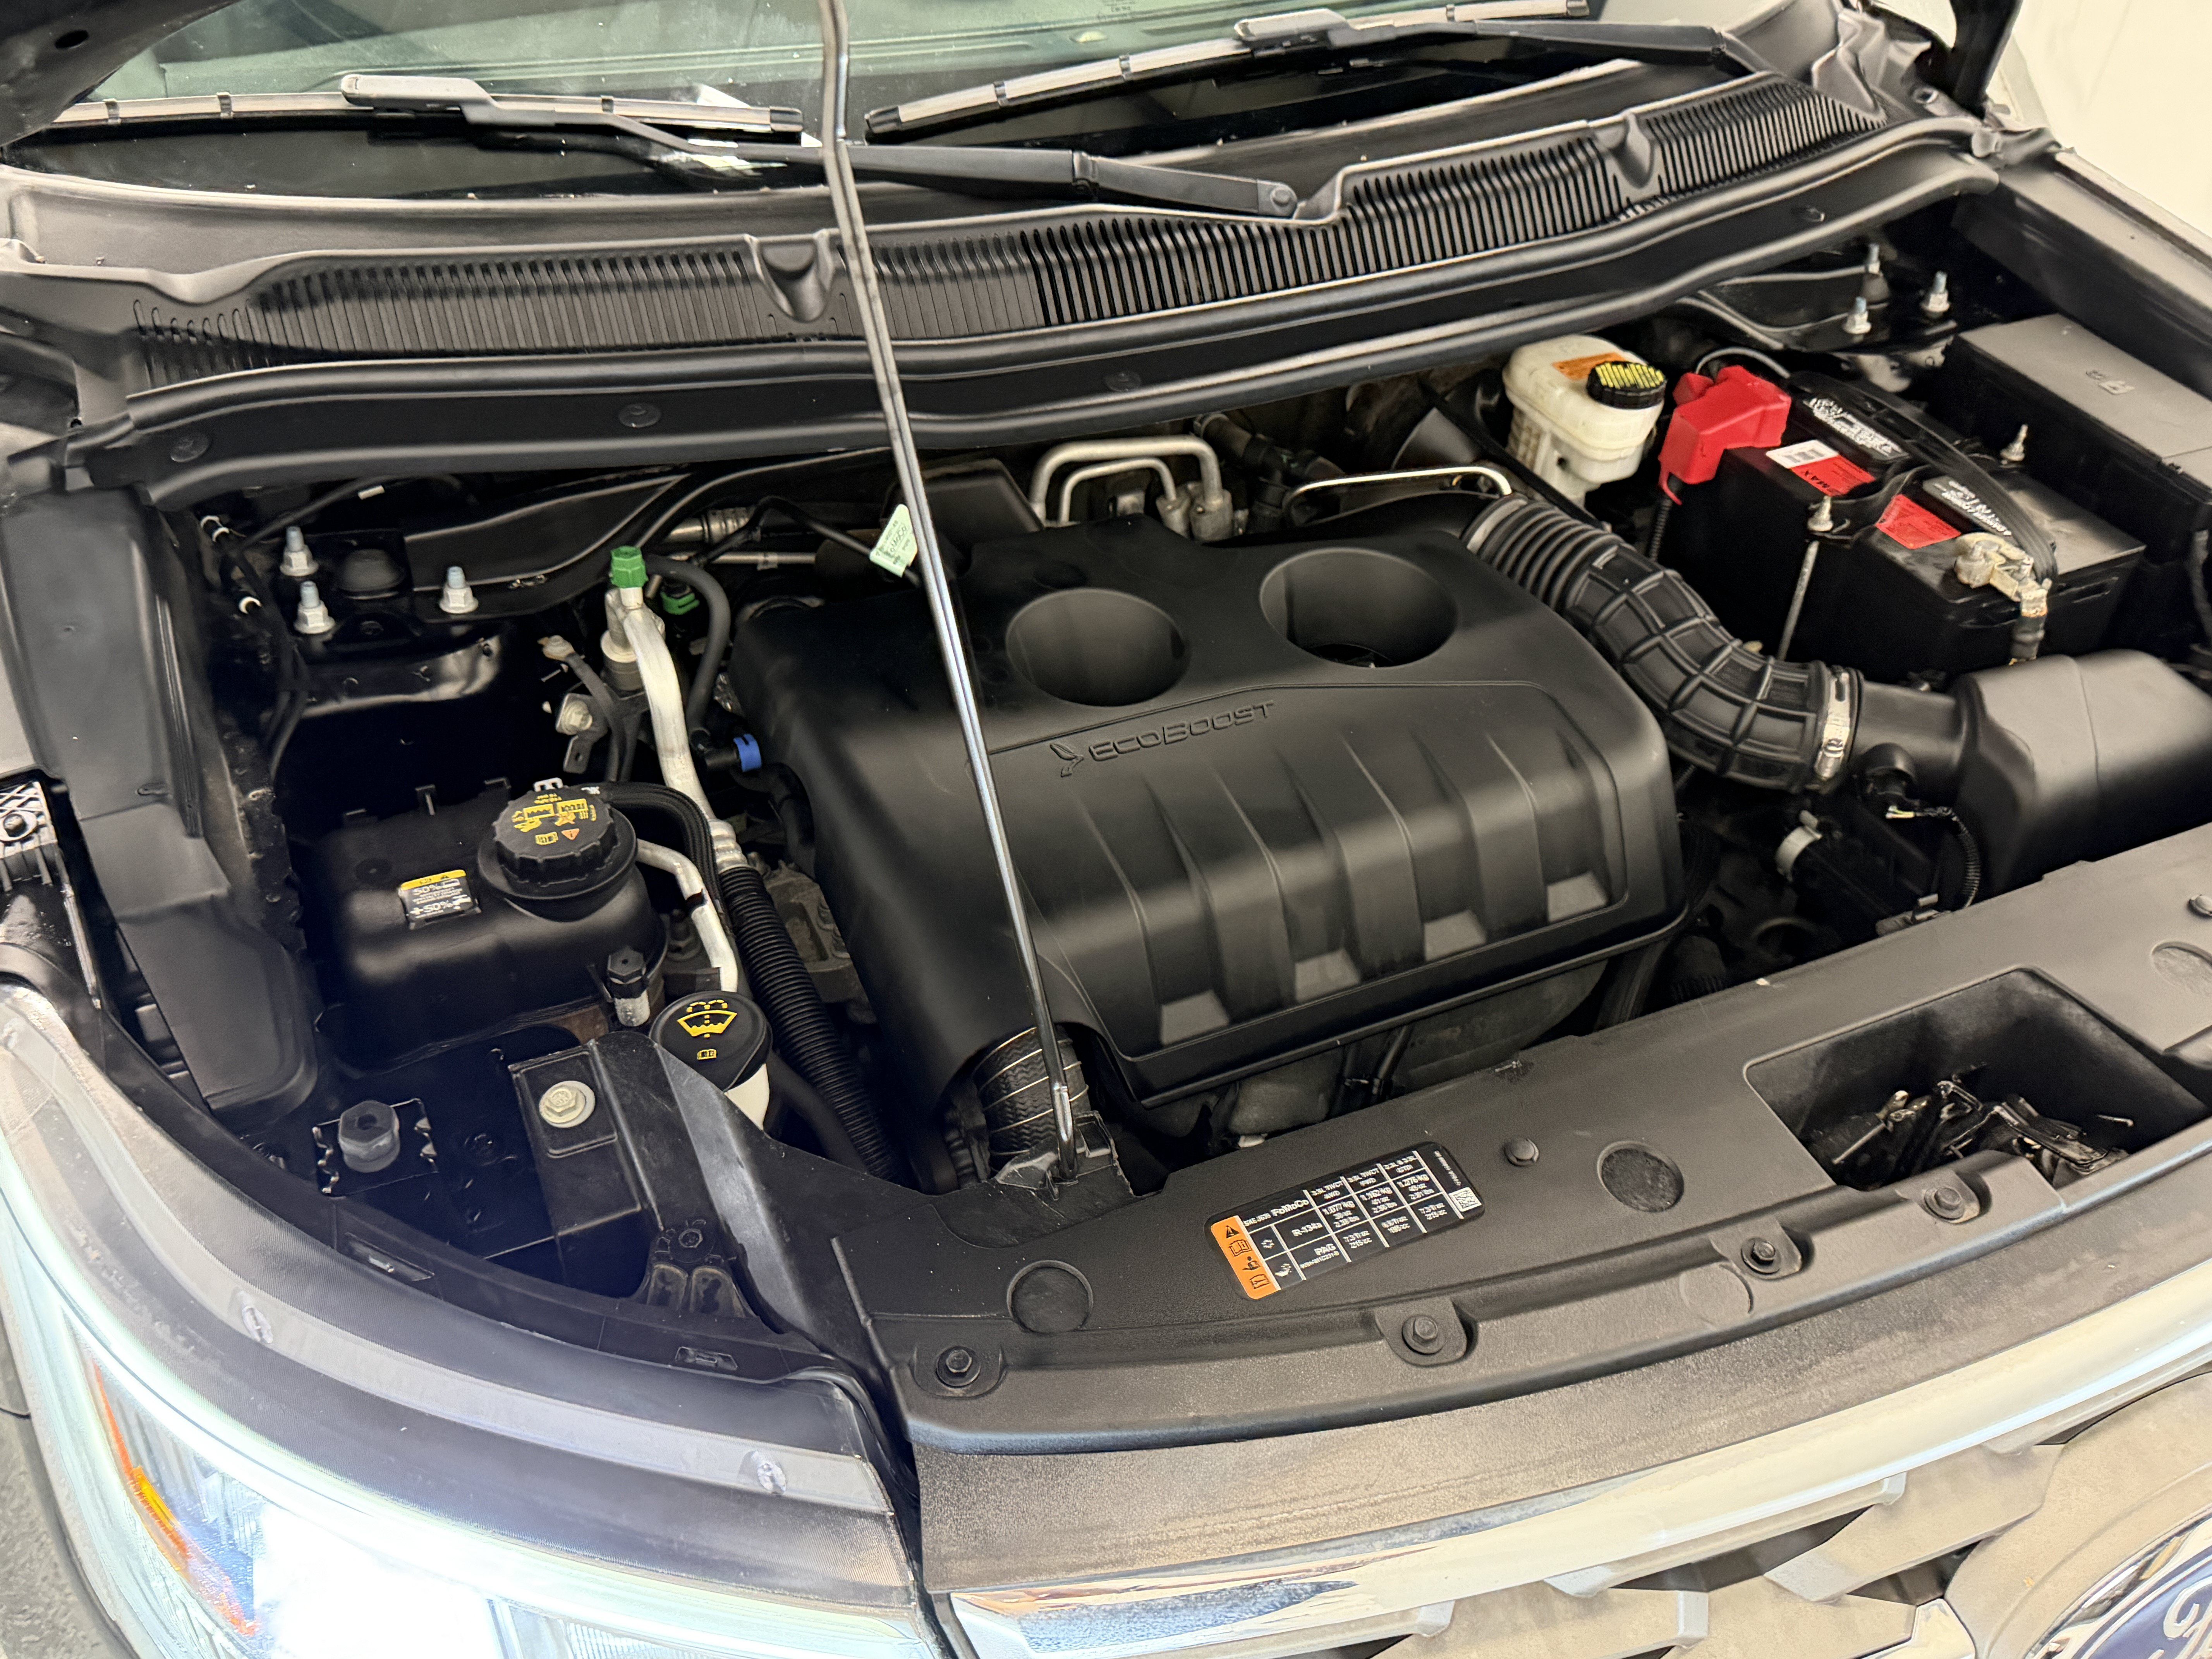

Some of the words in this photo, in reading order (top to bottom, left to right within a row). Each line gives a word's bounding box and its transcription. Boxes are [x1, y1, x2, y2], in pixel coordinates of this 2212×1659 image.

[1323, 1190, 1340, 1199] AWD
[1271, 1199, 1309, 1216] FoMoCo
[1243, 1218, 1257, 1226] SAE
[1291, 1223, 1323, 1237] R-134a
[1314, 1243, 1336, 1256] PAG
